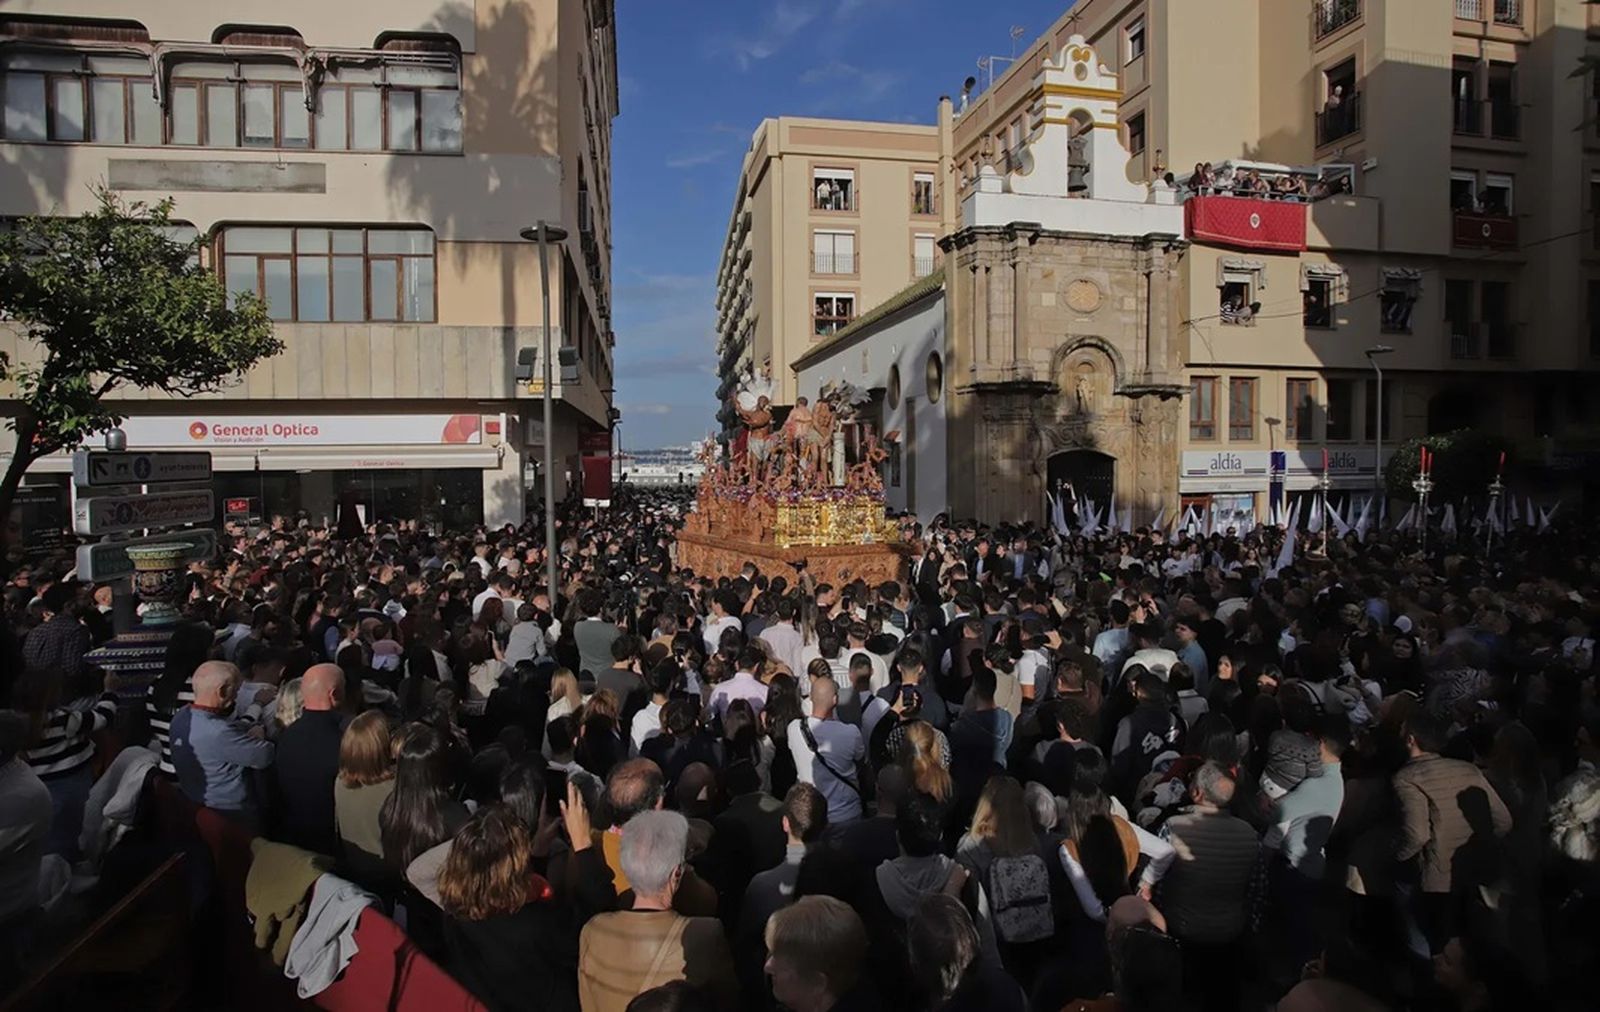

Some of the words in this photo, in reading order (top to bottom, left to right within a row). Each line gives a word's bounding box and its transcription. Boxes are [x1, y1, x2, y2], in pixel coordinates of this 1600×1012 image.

[212, 424, 268, 436] General
[272, 423, 319, 438] Optica
[1210, 452, 1242, 470] aldía
[1328, 452, 1356, 469] aldía
